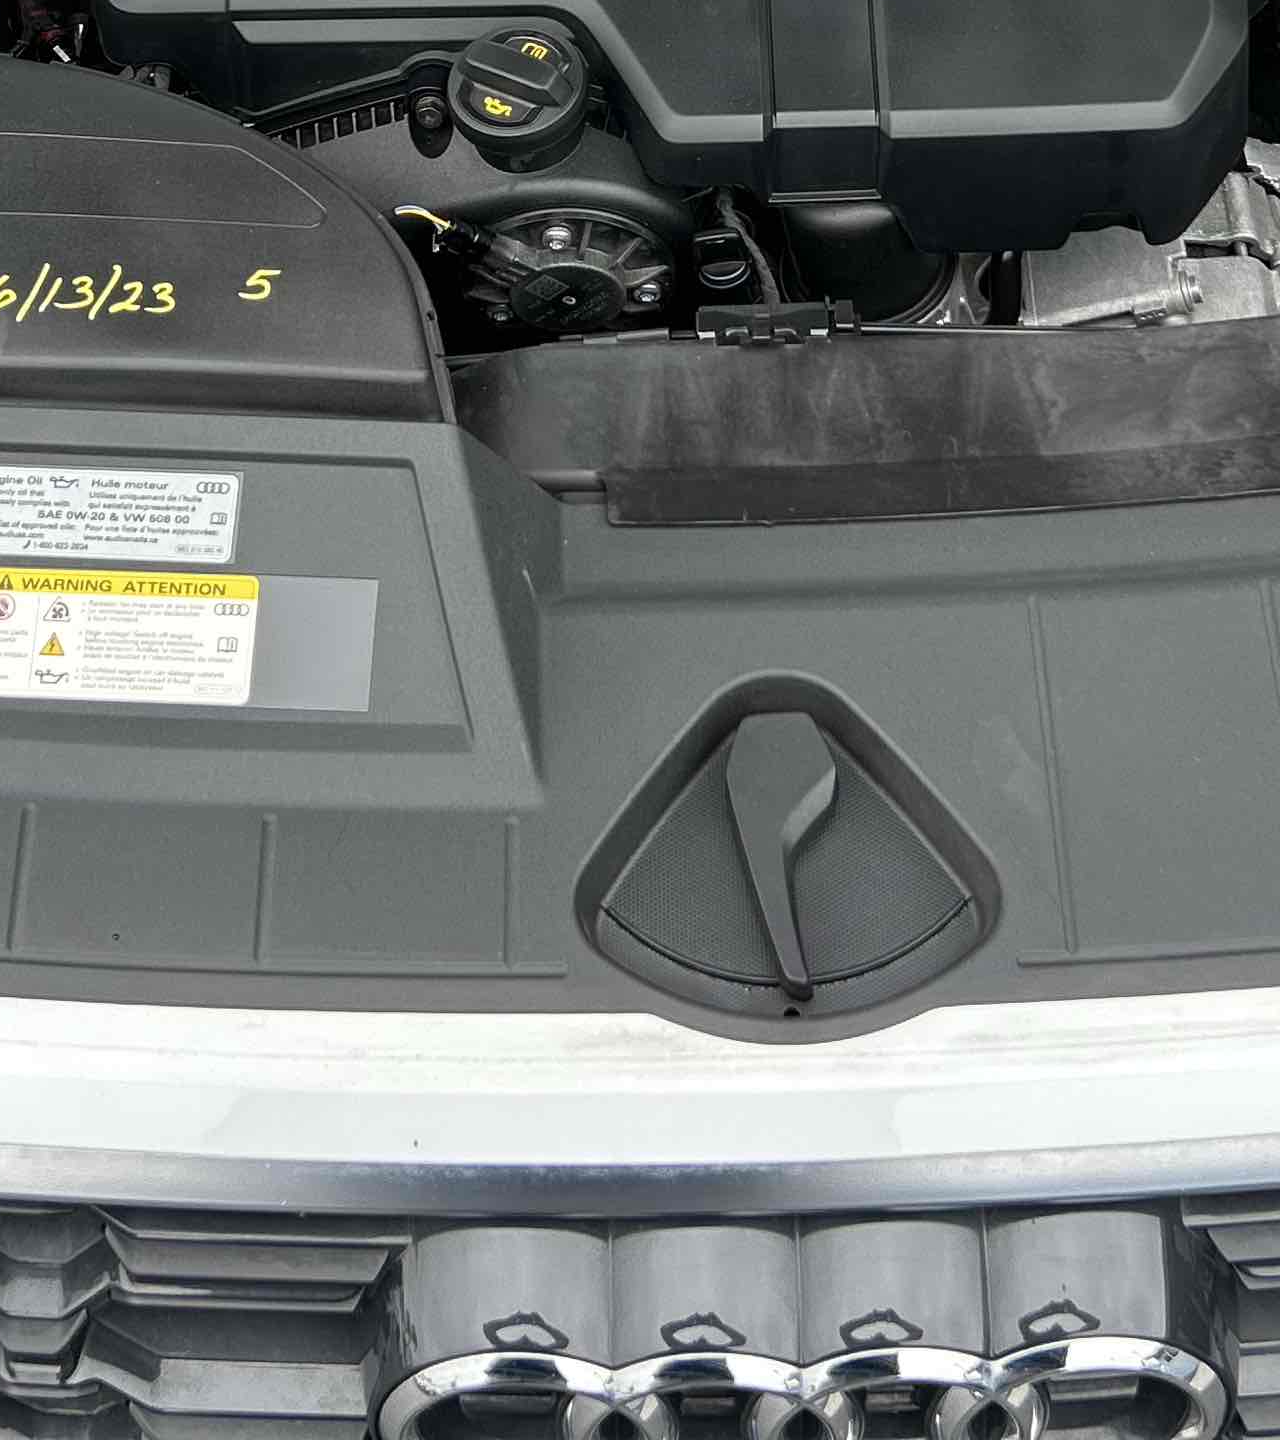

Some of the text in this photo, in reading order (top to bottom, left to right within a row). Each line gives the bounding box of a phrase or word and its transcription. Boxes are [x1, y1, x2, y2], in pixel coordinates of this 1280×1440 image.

[238, 269, 282, 300] 5
[27, 475, 43, 485] Oil
[124, 481, 168, 490] moteur
[38, 510, 63, 519] SAE
[109, 512, 119, 522] &
[124, 513, 147, 523] VW
[175, 514, 190, 524] 00
[22, 577, 227, 596] WARNING ATTENTION
